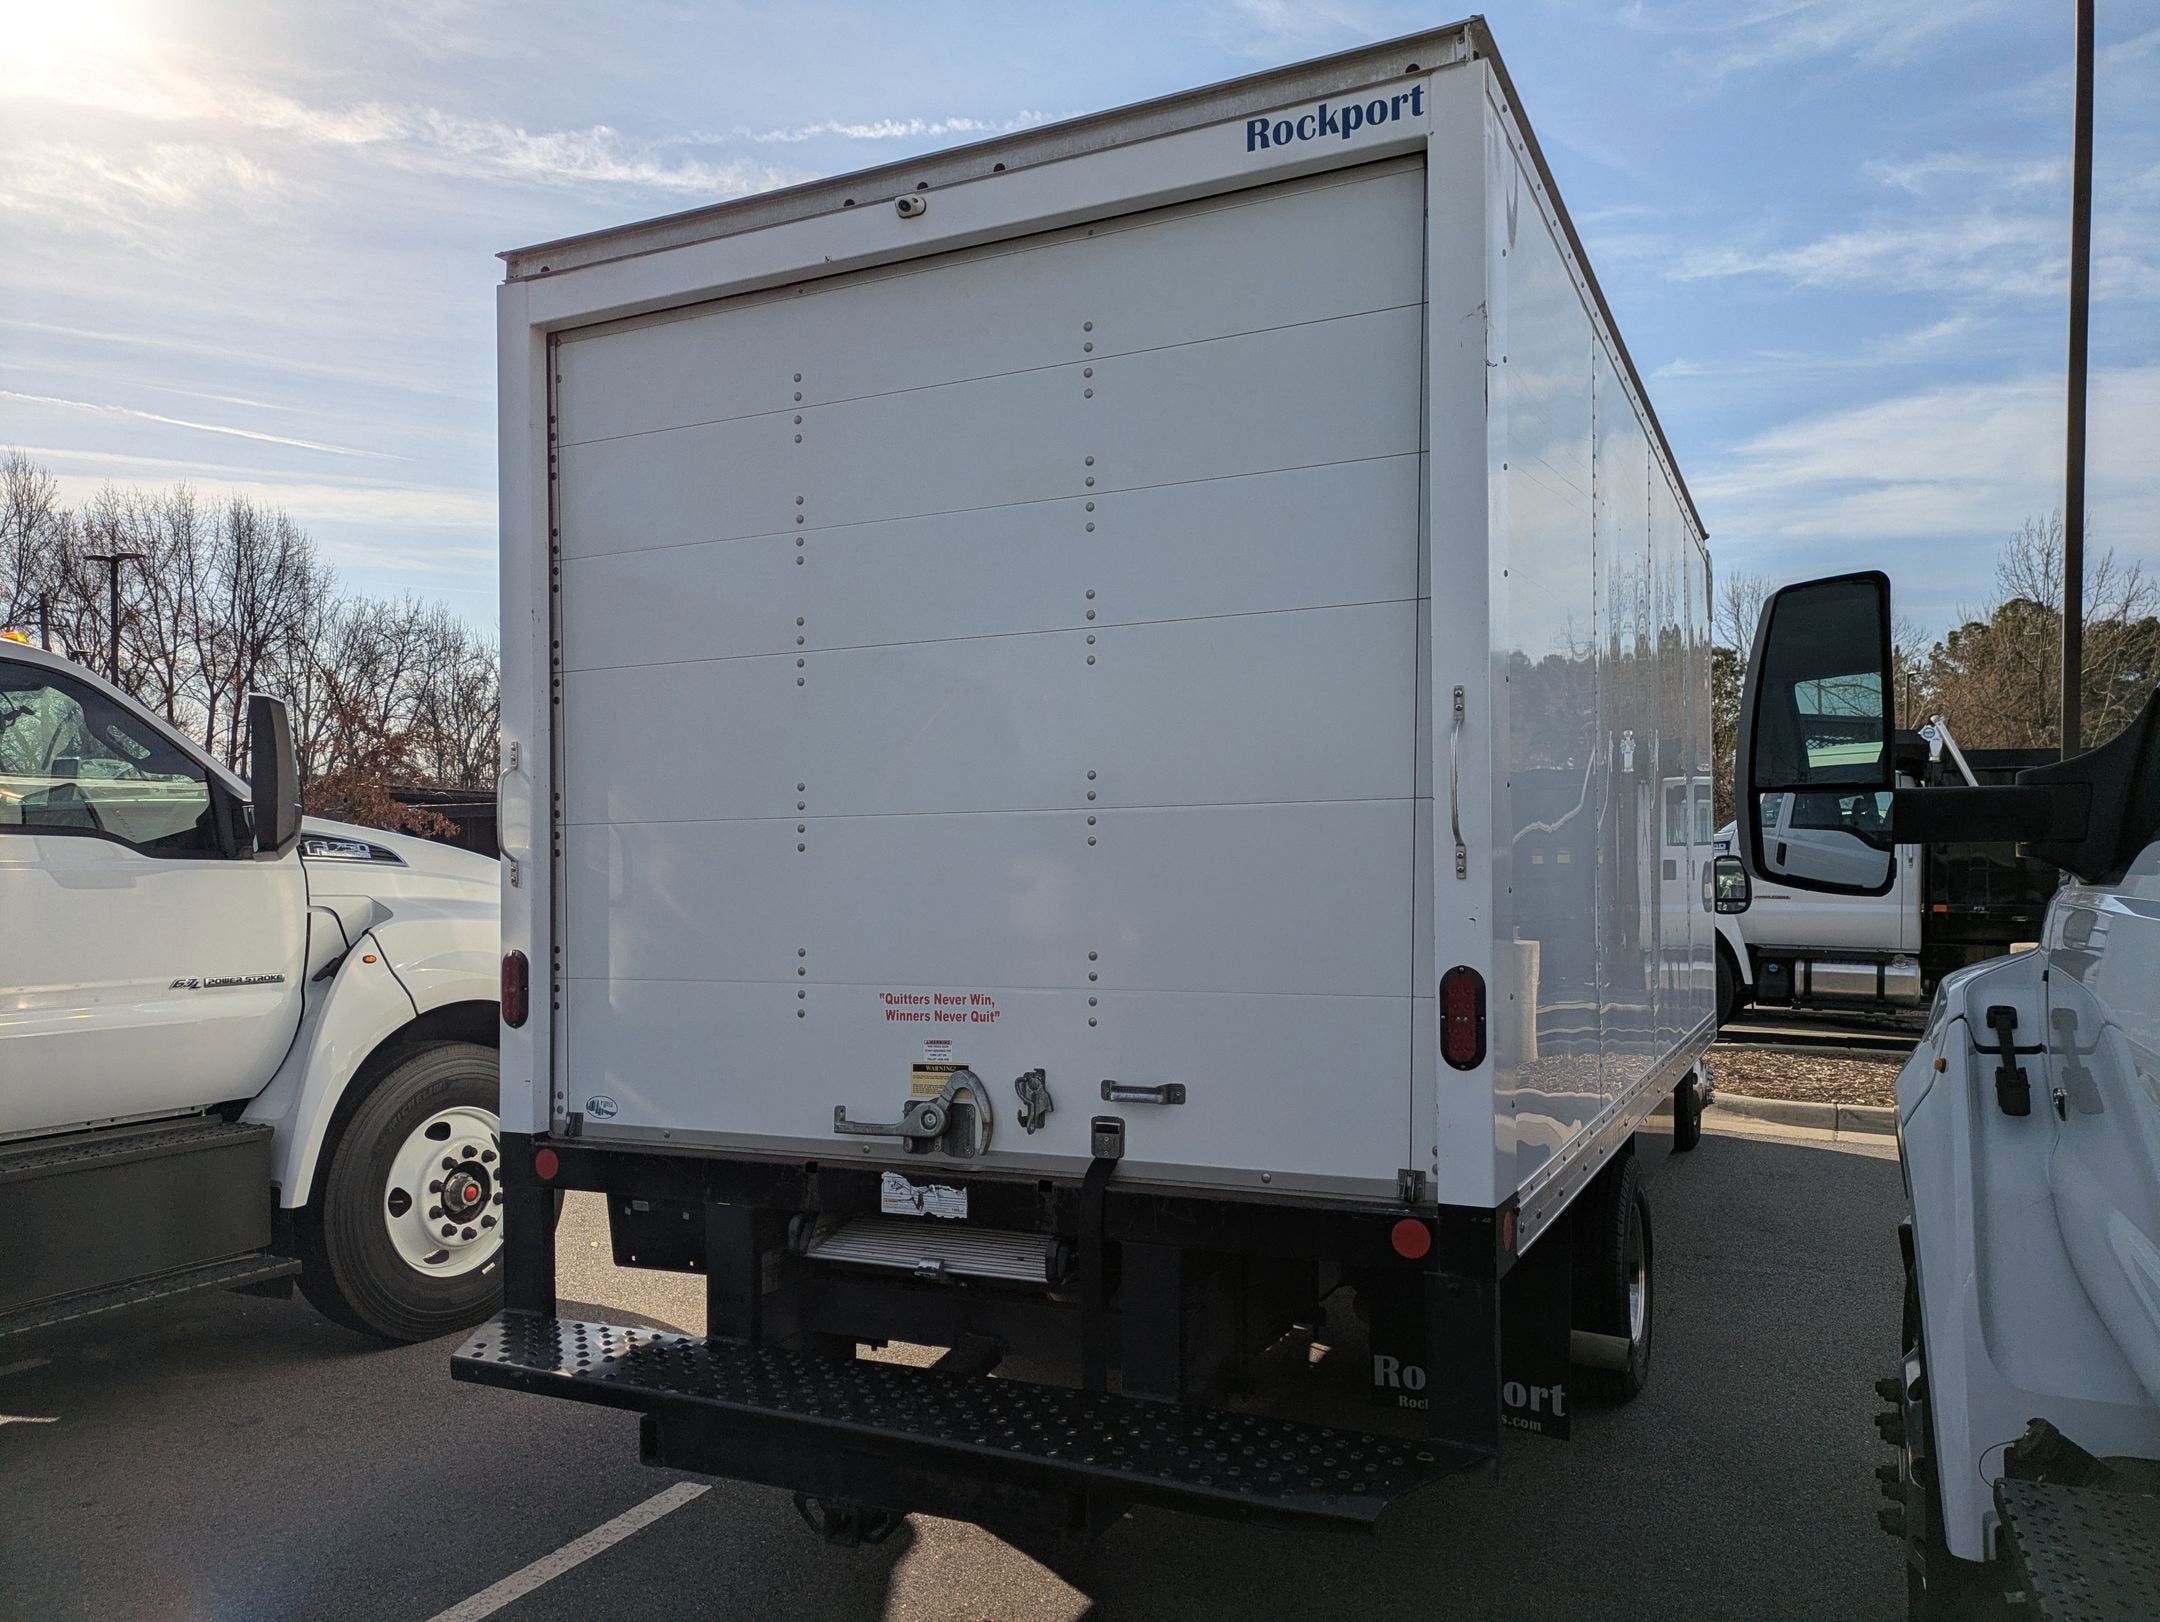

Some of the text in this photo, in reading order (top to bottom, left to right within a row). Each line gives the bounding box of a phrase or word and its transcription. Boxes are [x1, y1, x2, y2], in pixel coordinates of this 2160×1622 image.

[1246, 84, 1425, 152] Rockport
[208, 977, 242, 985] POWER
[245, 974, 283, 983] STROKE
[934, 993, 967, 1005] Never
[970, 993, 995, 1008] Win,
[886, 1009, 931, 1022] Winners
[934, 1010, 967, 1023] Never
